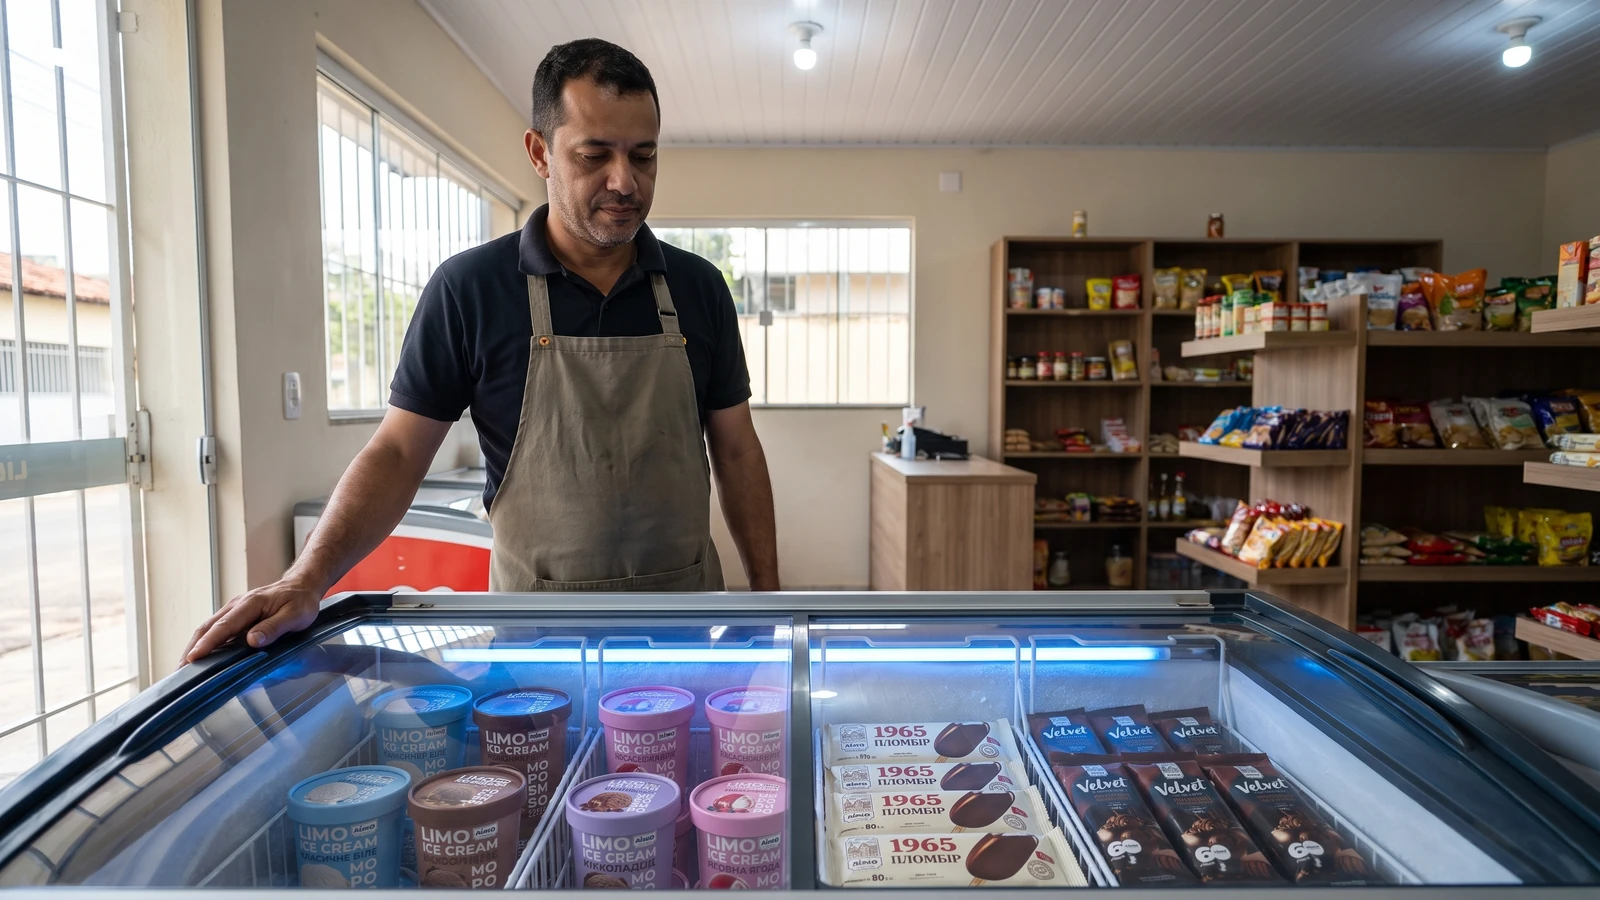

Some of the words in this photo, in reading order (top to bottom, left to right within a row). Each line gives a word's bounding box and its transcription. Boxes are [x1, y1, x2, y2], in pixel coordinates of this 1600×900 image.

[382, 728, 423, 743] LIMO
[485, 730, 526, 746] LIMO
[613, 730, 655, 746] LIMO
[719, 728, 760, 745] LIMO
[874, 725, 927, 738] 1965
[1043, 725, 1088, 739] Velvet
[1109, 725, 1153, 739] Velvet
[1173, 726, 1218, 738] Velvet
[634, 740, 676, 755] CREAM
[739, 741, 780, 755] CREAM
[874, 738, 930, 747] ПЛОМБІР
[877, 765, 934, 778] 1965
[877, 778, 937, 786] ПЛОМБІР
[1076, 777, 1127, 793] Velvet
[1154, 778, 1207, 796] Velvet
[1235, 778, 1289, 794] Velvet
[881, 793, 942, 807] 1965
[882, 807, 945, 816] ПЛОМБІР
[299, 823, 348, 842] LIMO
[421, 826, 470, 844] LIMO
[300, 839, 317, 853] ICE
[321, 835, 378, 854] CREAM
[422, 841, 441, 856] ICE
[445, 838, 498, 857] CREAM
[582, 832, 630, 851] LIMO
[707, 833, 755, 853] LIMO
[889, 837, 957, 853] 1965
[583, 847, 602, 862] ICE
[605, 846, 657, 864] CREAM
[708, 848, 727, 864] ICE
[731, 848, 780, 865] CREAM
[891, 854, 961, 864] ПЛОМБІР
